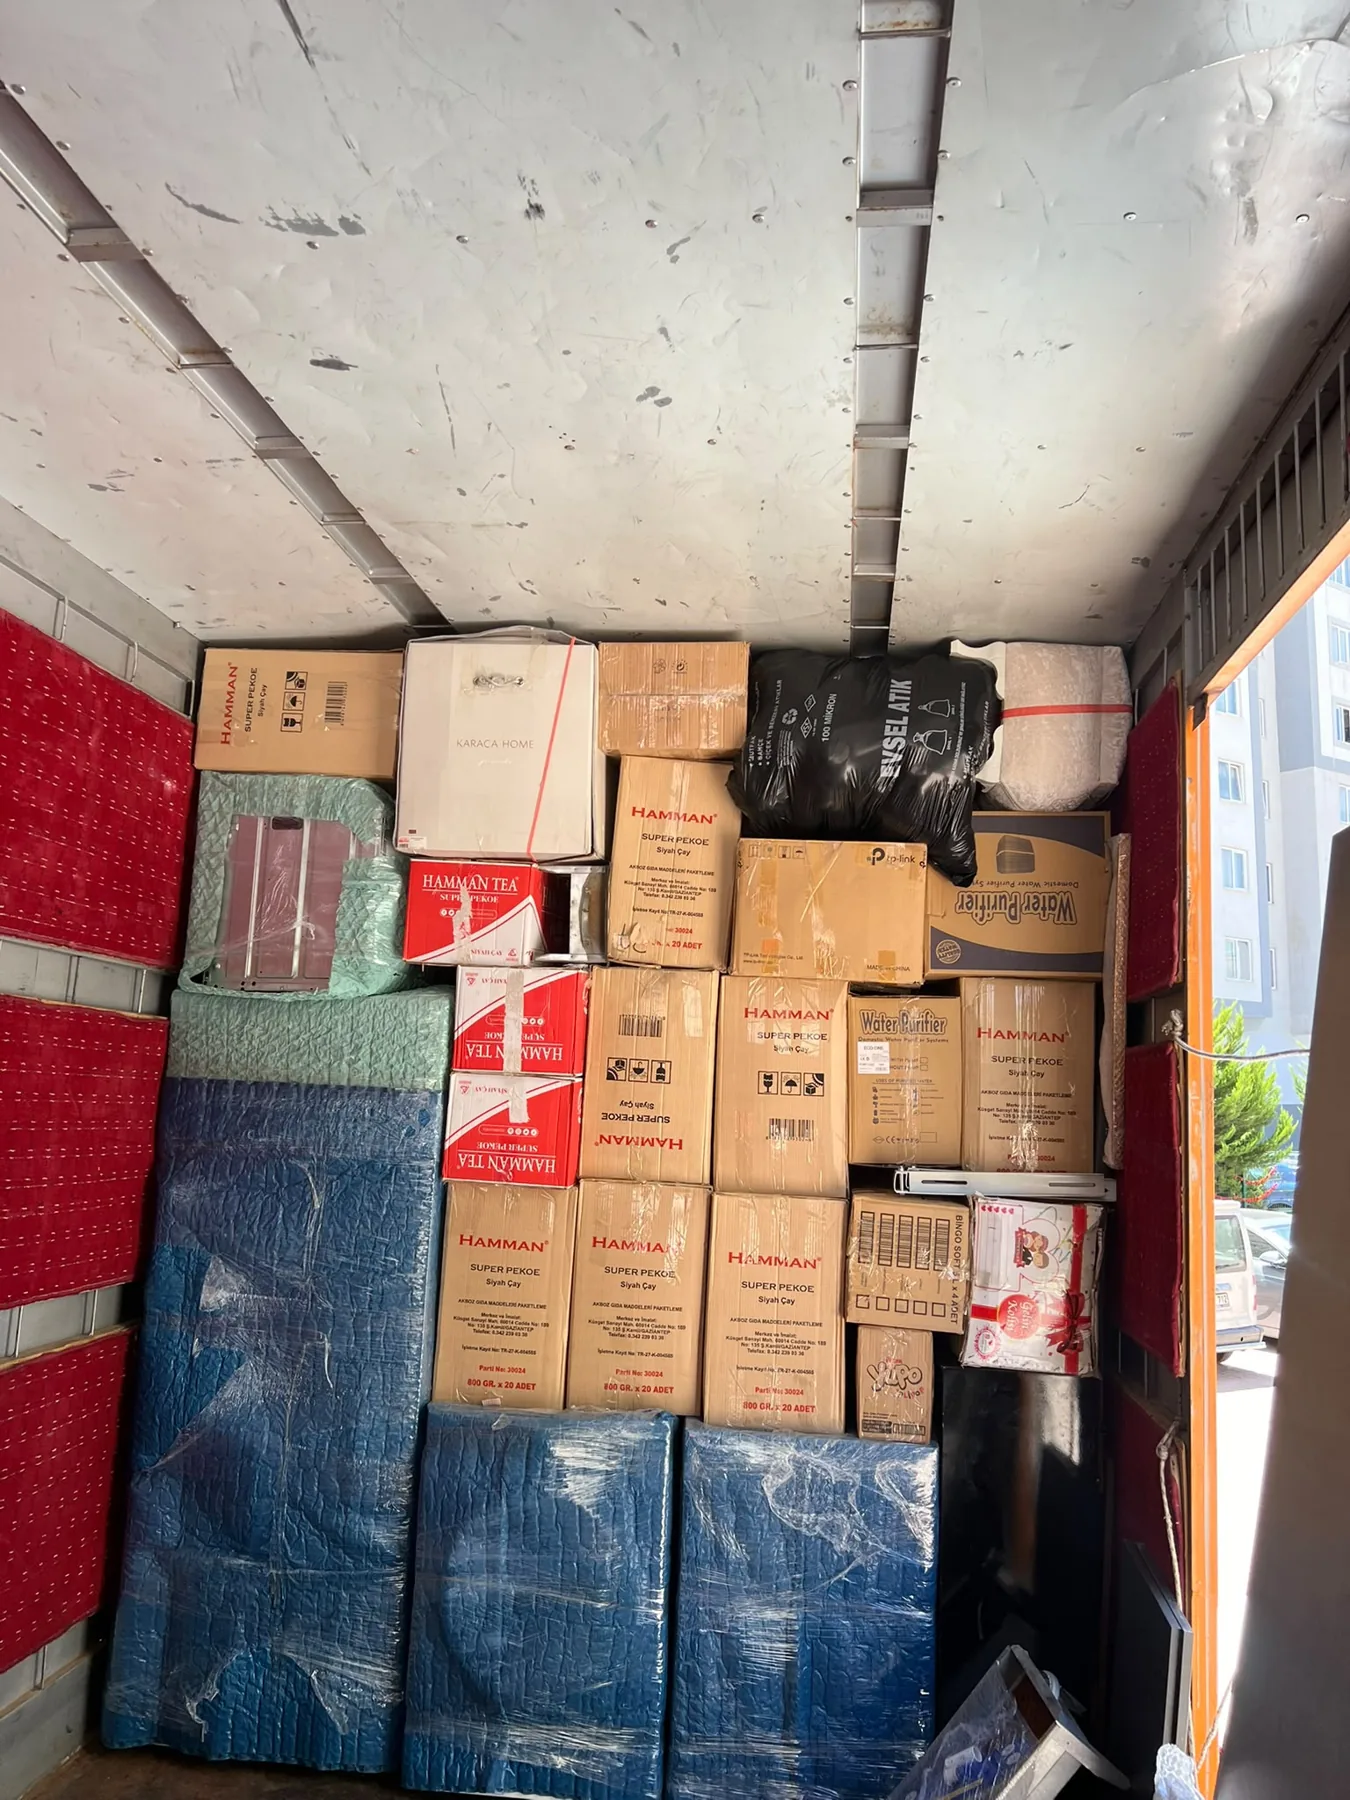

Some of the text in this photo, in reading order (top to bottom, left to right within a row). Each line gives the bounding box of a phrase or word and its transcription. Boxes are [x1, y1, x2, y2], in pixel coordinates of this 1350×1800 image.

[244, 667, 258, 733] SUPER PEKOE
[889, 679, 913, 715] ATIK
[220, 666, 238, 744] HAMMAN
[821, 693, 838, 742] 100 MİKRON
[456, 739, 534, 749] KARACA HOME
[632, 806, 713, 824] HAMMAN
[641, 833, 709, 846] SUPER PEKOE
[656, 846, 691, 857] Siyah Çay
[887, 851, 915, 864] tp-link
[422, 874, 518, 892] HAMMAN TEA
[957, 891, 1076, 924] Water Purifier
[674, 927, 693, 935] 30024
[672, 940, 702, 950] 20 ADET
[744, 1007, 829, 1021] HAMMAN
[861, 1010, 946, 1034] Water Purifier
[757, 1032, 828, 1041] SUPER PEKOE
[977, 1027, 1065, 1043] HAMMAN
[466, 1044, 492, 1060] TEA
[991, 1055, 1063, 1066] SUPER PEKOE
[620, 1100, 655, 1110] Siyah Çay
[601, 1112, 671, 1124] SUPER PEKOE
[477, 1142, 538, 1152] SUPER PEKOE
[600, 1134, 683, 1150] HAMMAN
[458, 1152, 556, 1173] HAMMAN TEA
[955, 1215, 963, 1244] BİNGO
[459, 1234, 544, 1253] HAMMAN
[728, 1252, 817, 1269] HAMMAN
[953, 1245, 962, 1269] SOFT
[470, 1264, 540, 1276] SUPER PEKOE
[604, 1266, 676, 1279] SUPER PEKOE
[486, 1278, 521, 1289] Siyah Çay
[620, 1281, 657, 1291] Siyah Çay
[741, 1281, 815, 1293] SUPER PEKOE
[758, 1295, 796, 1306] Siyah Çay
[950, 1300, 959, 1325] ADET
[479, 1365, 493, 1373] Parti
[507, 1367, 526, 1375] 30024
[615, 1369, 631, 1377] Parti
[644, 1370, 664, 1378] 30024
[467, 1378, 482, 1386] 800
[483, 1379, 496, 1388] GR.
[504, 1381, 515, 1389] 20
[516, 1382, 537, 1391] ADET
[604, 1383, 618, 1391] 800
[620, 1384, 634, 1392] GR.
[641, 1385, 652, 1393] 20
[653, 1385, 674, 1394] ADET
[755, 1386, 770, 1394] Parti
[784, 1388, 804, 1396] 30024
[743, 1401, 757, 1410] 800
[759, 1402, 774, 1411] GR.
[782, 1404, 792, 1412] 20
[793, 1404, 816, 1413] ADET
